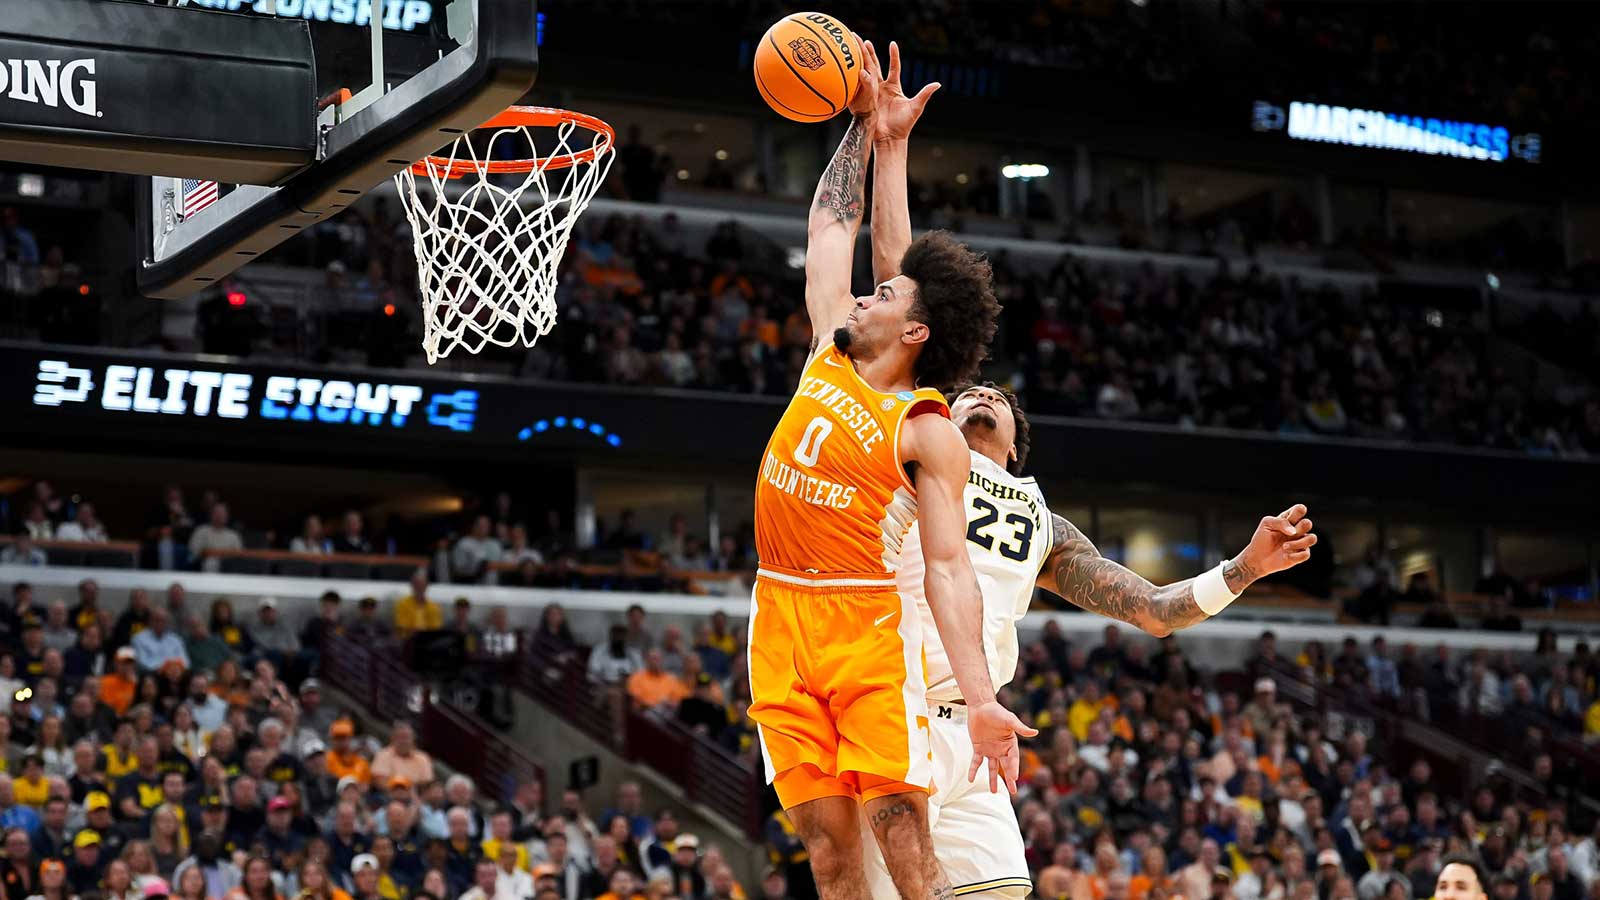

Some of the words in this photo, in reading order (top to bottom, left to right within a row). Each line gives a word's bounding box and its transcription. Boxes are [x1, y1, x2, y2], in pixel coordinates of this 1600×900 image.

[806, 13, 856, 70] Wilson
[101, 365, 253, 419] ELITE
[260, 376, 423, 426] EIGHT
[801, 376, 885, 454] TENNESSEE
[793, 415, 834, 468] 0
[966, 497, 1034, 562] 23
[937, 705, 953, 720] M
